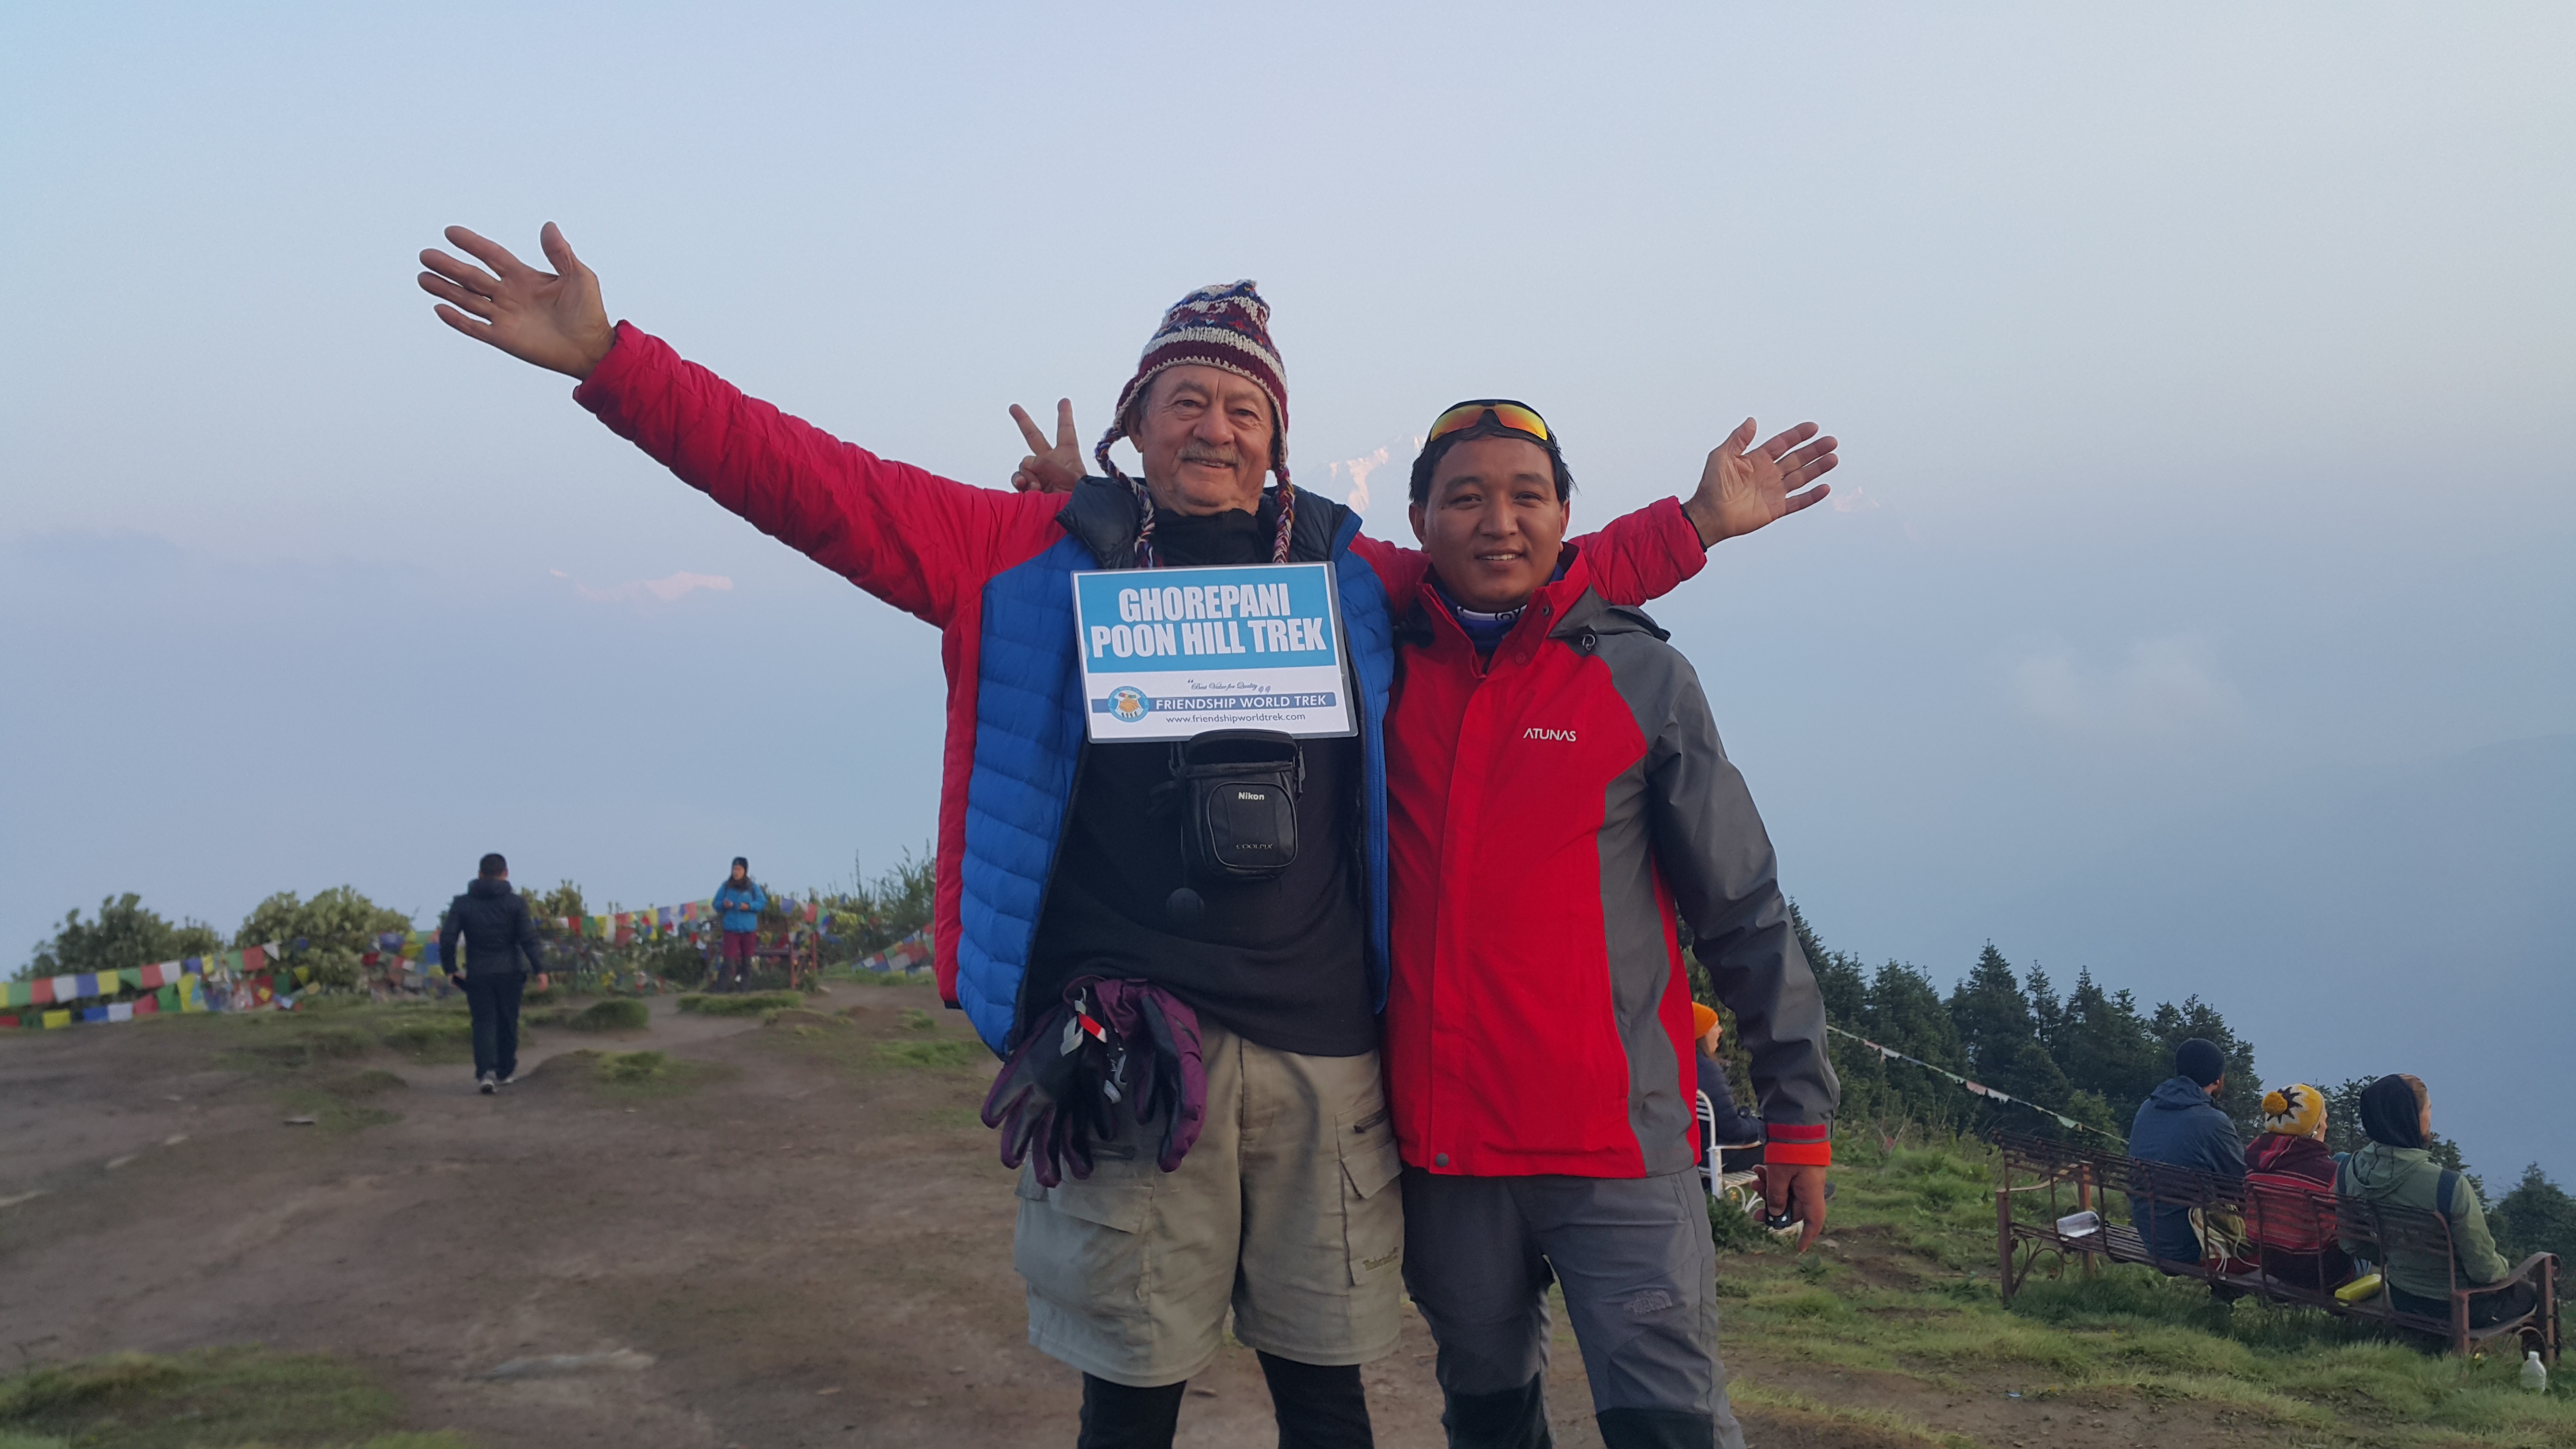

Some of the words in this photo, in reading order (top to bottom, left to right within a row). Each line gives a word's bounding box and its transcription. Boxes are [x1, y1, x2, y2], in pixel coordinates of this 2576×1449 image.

[1119, 583, 1291, 622] GHOREPANI
[1091, 624, 1177, 658] POON
[1181, 621, 1246, 655] HILL
[1247, 617, 1327, 653] TREK
[1156, 698, 1236, 710] FRIENDSHIP
[1240, 696, 1290, 708] WORLD
[1294, 695, 1327, 706] TREK
[1166, 713, 1305, 724] www.friendshipworldtrek.com
[1523, 727, 1577, 742] ATUNAS
[1238, 791, 1265, 800] Nikon
